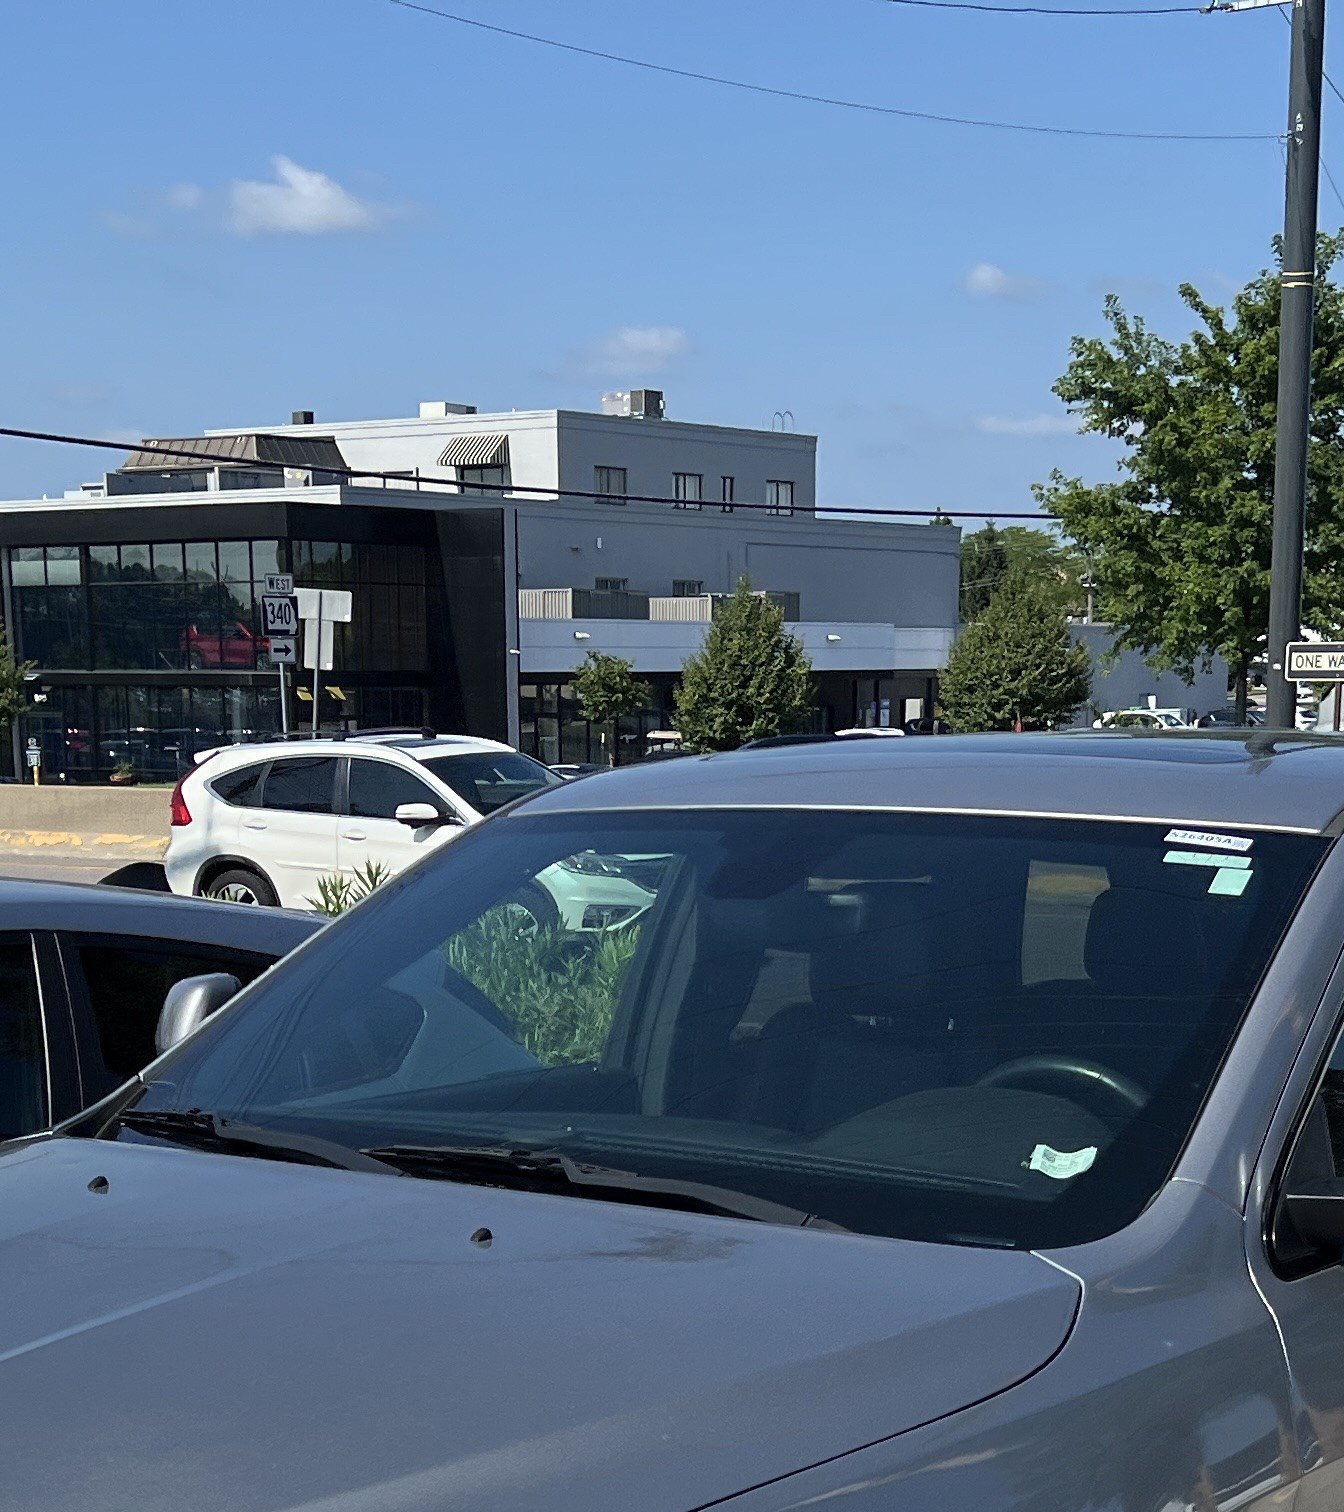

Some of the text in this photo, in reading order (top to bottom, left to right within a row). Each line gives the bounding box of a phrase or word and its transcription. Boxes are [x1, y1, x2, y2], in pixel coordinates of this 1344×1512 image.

[268, 577, 290, 590] WEST
[268, 603, 291, 624] 340
[1295, 654, 1323, 669] ONE
